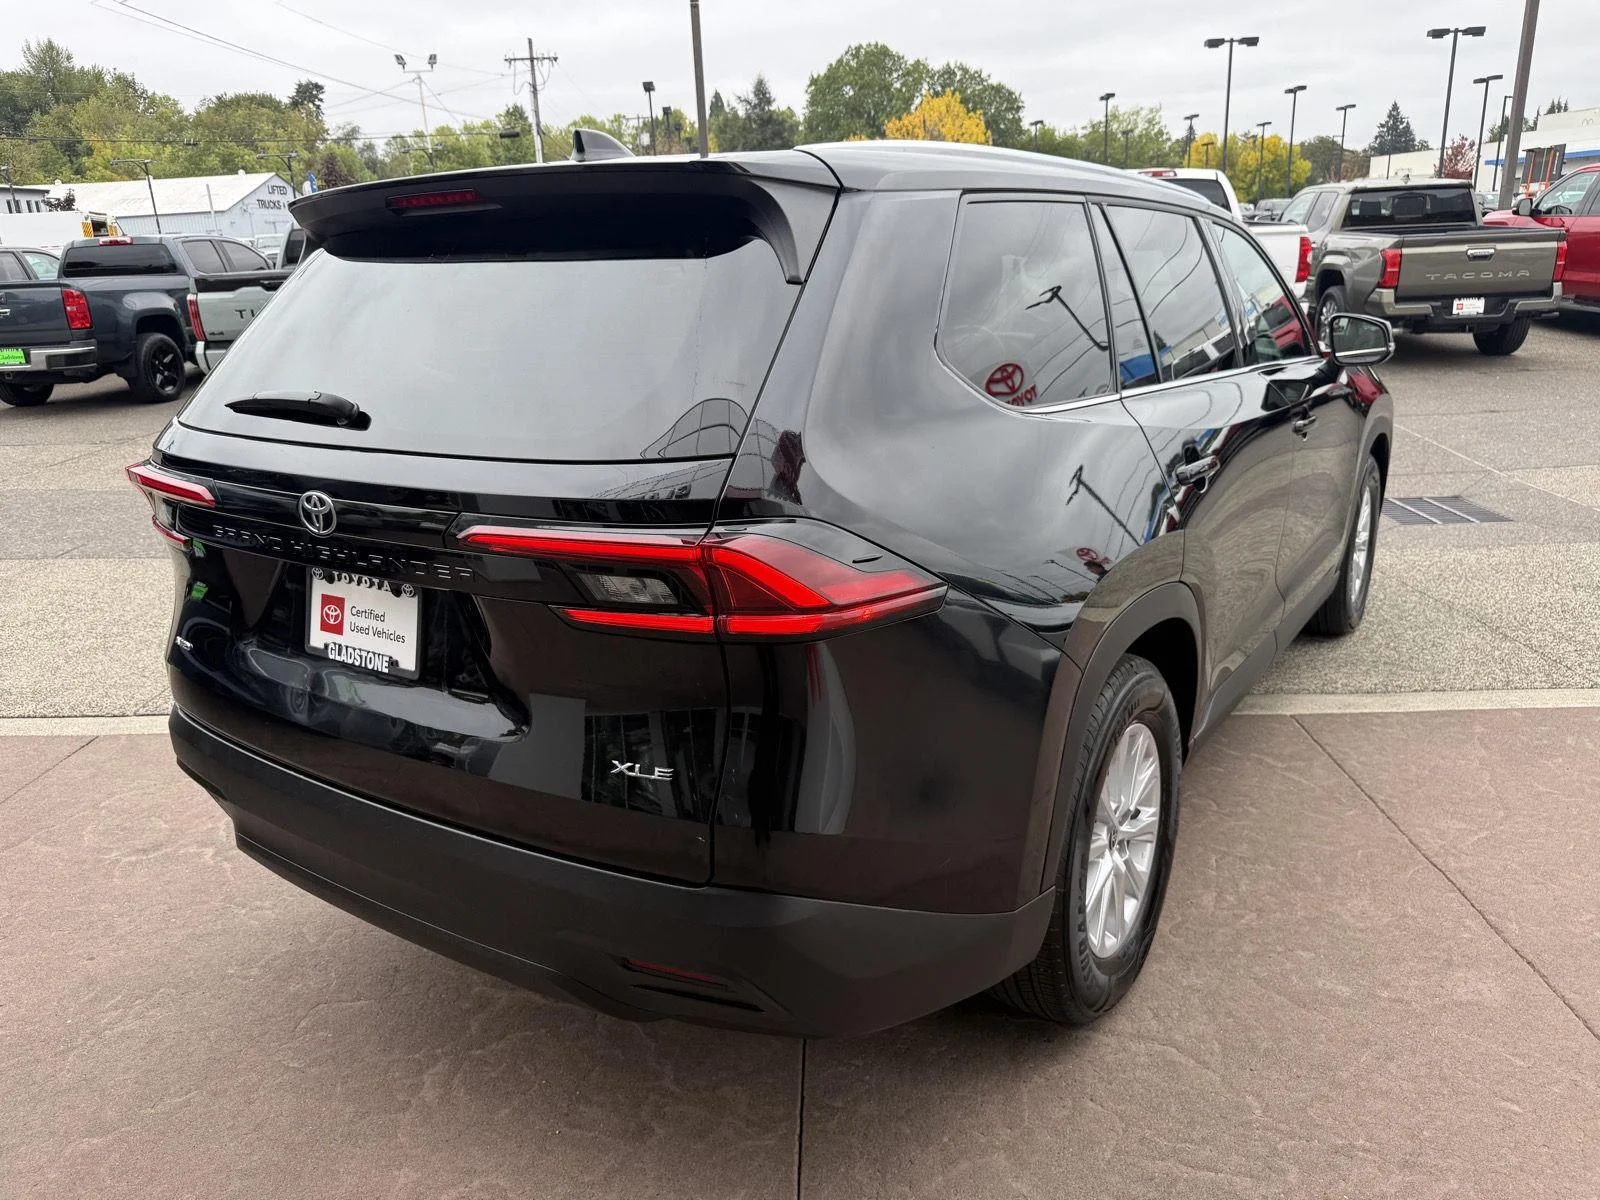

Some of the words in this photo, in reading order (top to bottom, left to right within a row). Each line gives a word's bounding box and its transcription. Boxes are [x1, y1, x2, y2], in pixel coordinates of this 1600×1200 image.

[267, 184, 288, 196] LIFTED
[256, 199, 282, 210] TRUCKS
[1425, 269, 1530, 281] TACOMA
[212, 523, 283, 551] GRAND
[289, 539, 474, 582] HIGHLANDER
[332, 571, 392, 593] TOYOTA
[350, 605, 386, 623] Certified
[349, 621, 371, 637] Used
[371, 626, 406, 644] Vehicles
[327, 641, 390, 674] GLADSTONE
[610, 759, 675, 781] XLE
